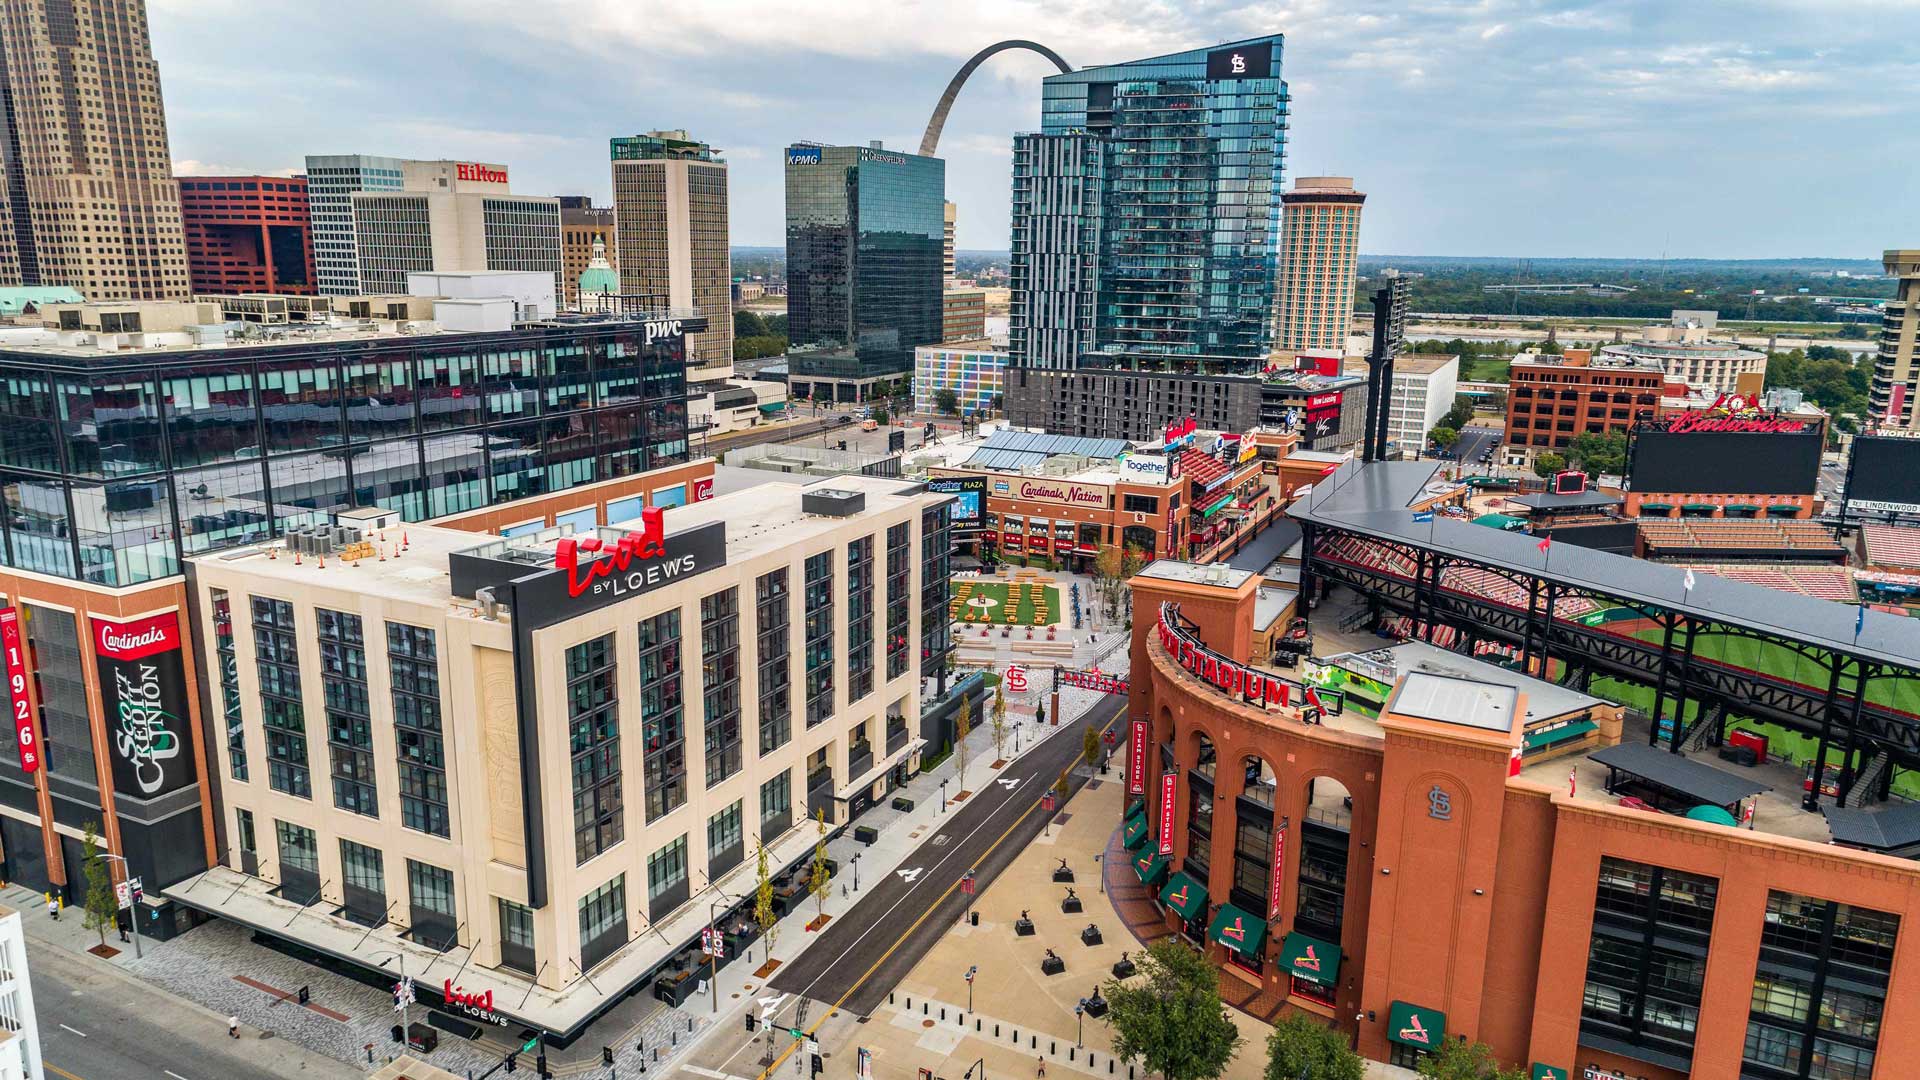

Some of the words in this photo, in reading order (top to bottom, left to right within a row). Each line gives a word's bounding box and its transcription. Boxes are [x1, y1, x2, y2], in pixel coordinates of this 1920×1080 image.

[788, 155, 818, 165] KPMG
[456, 163, 508, 184] Hilton
[644, 320, 682, 345] pwc
[1666, 409, 1805, 433] Budweiser
[1126, 459, 1167, 472] Together
[963, 481, 984, 489] PLAZA
[1020, 481, 1065, 500] Cardinals
[1064, 487, 1103, 503] Nation
[1865, 501, 1918, 512] LINDENWOOD
[593, 580, 611, 595] BY
[613, 554, 696, 596] LOEWS
[101, 625, 167, 653] Cardinals
[1180, 640, 1290, 708] STADIUM
[8, 647, 33, 746] 1926
[444, 978, 494, 1012] Live!
[463, 1004, 508, 1027] LOEWS
